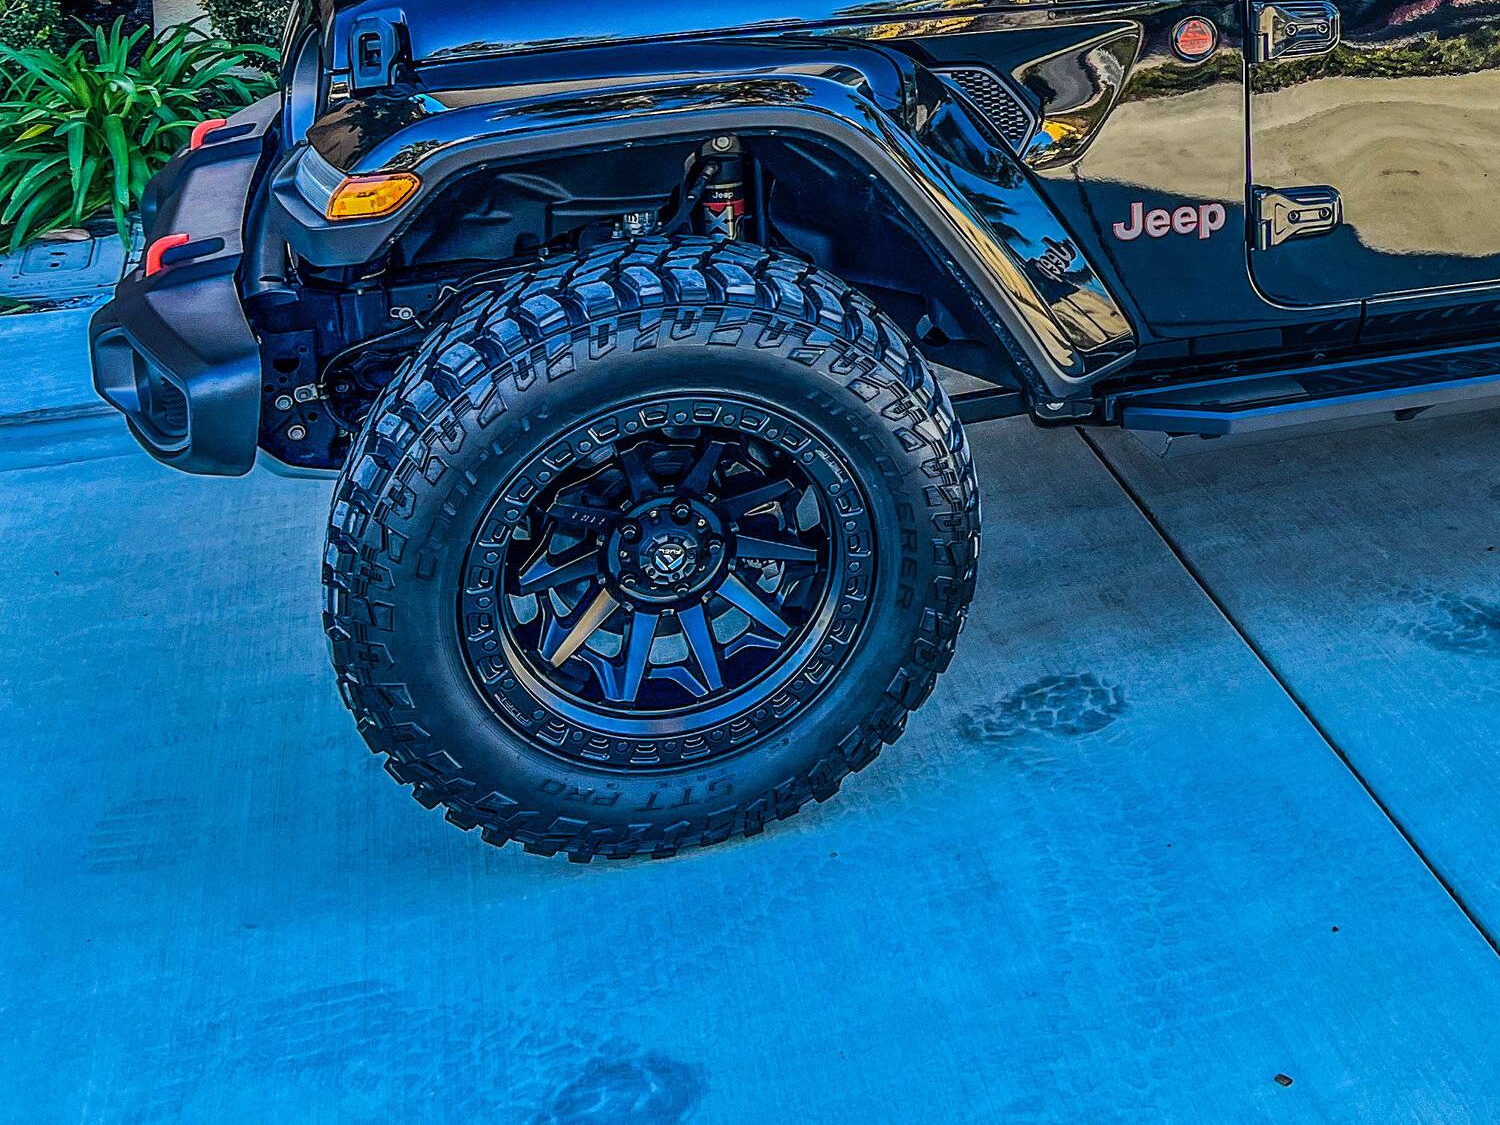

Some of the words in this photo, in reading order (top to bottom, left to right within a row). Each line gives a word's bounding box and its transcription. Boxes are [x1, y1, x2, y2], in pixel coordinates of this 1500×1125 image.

[712, 191, 734, 199] Jeep
[1113, 202, 1226, 241] Jeep
[539, 779, 621, 807] PRO
[633, 776, 735, 811] STT
